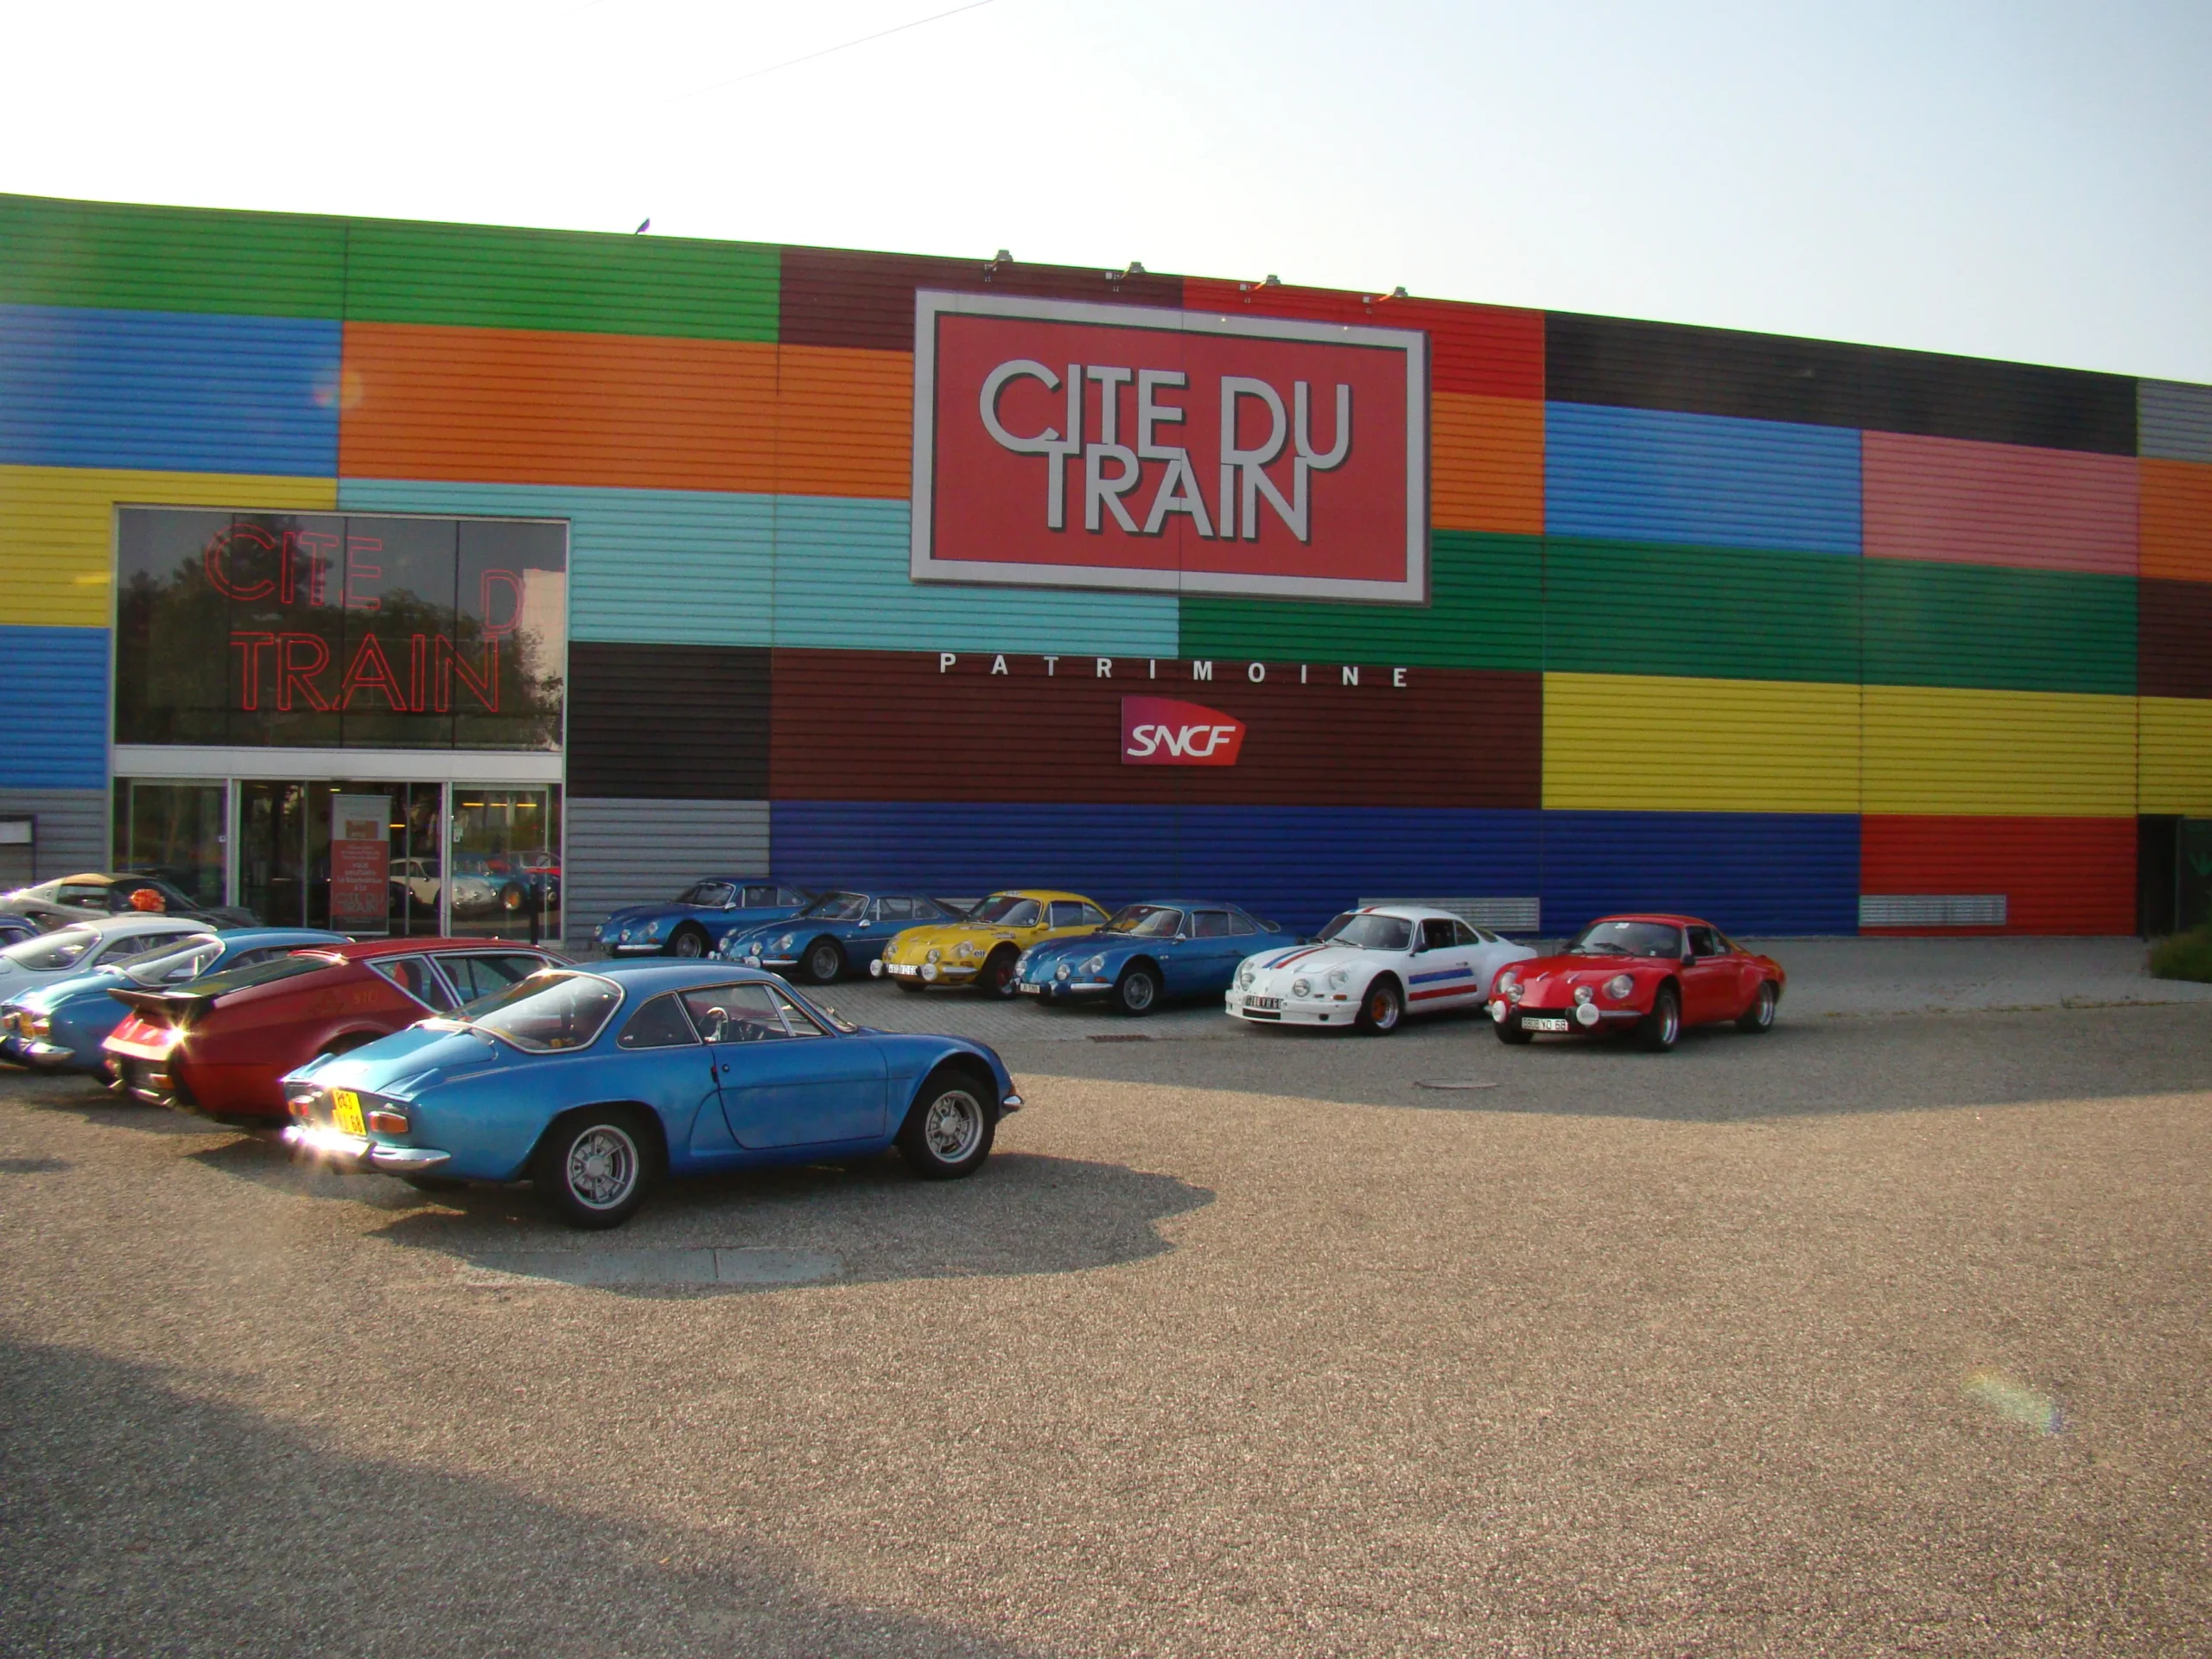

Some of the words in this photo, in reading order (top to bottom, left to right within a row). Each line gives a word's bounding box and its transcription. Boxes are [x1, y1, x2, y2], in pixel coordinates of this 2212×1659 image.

[979, 359, 1187, 461] CITE
[1221, 376, 1351, 470] DU
[1044, 440, 1308, 542] TRAIN
[205, 524, 383, 609] CITE
[230, 632, 499, 713] TRAIN
[939, 652, 1408, 688] PATRIMOINE
[1126, 724, 1236, 758] SNCF
